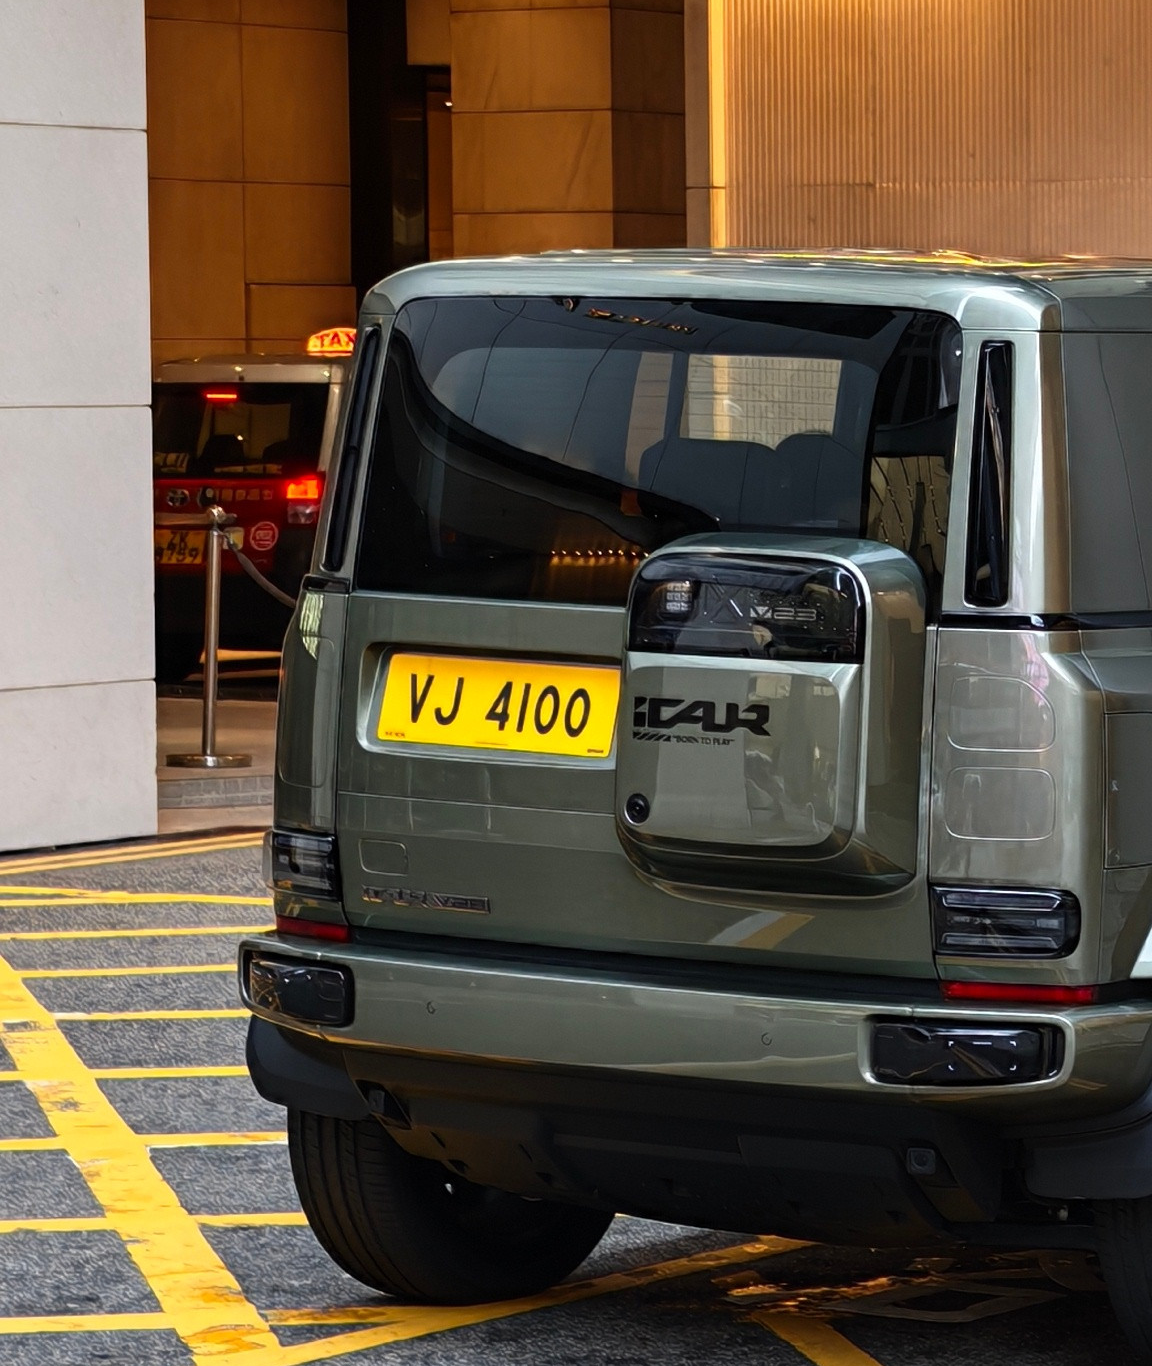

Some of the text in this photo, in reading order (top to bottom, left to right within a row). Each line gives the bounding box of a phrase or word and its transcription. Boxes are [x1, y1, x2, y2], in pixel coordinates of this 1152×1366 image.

[315, 331, 356, 348] TAX
[410, 673, 592, 739] VJ 4100
